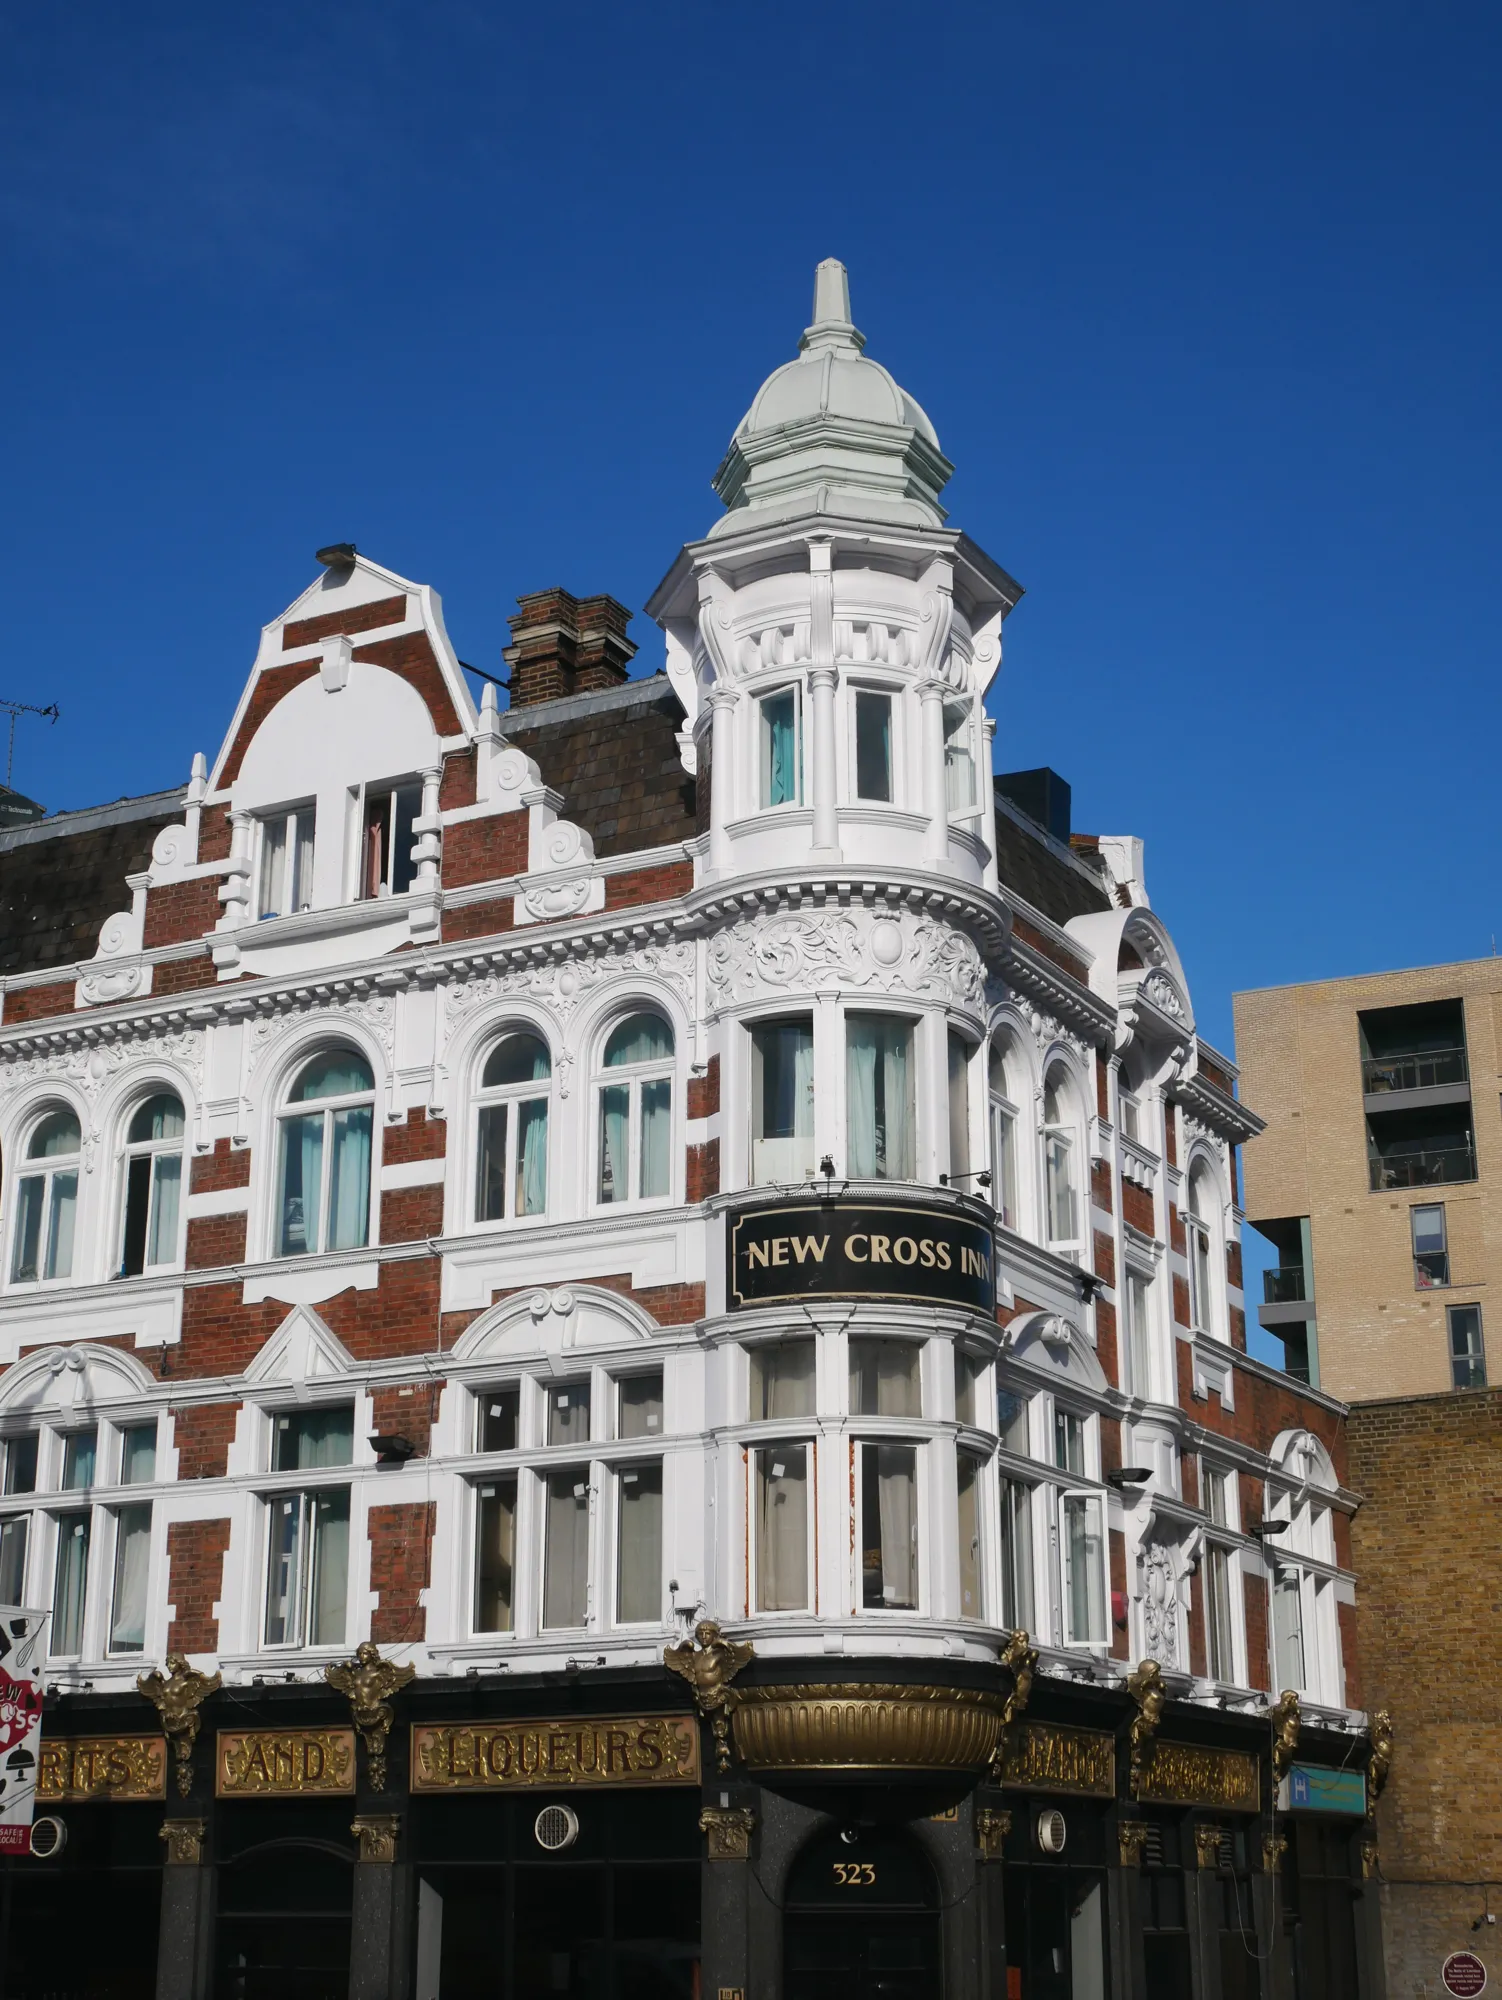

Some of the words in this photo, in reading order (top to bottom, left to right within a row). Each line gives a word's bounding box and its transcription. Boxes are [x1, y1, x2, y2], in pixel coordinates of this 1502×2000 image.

[748, 1234, 830, 1270] NEW
[844, 1233, 951, 1271] CROSS
[960, 1246, 990, 1282] INN
[38, 1750, 131, 1789] RITS
[243, 1742, 325, 1782] AND
[448, 1729, 664, 1778] LIQUEURS
[832, 1863, 876, 1884] 323
